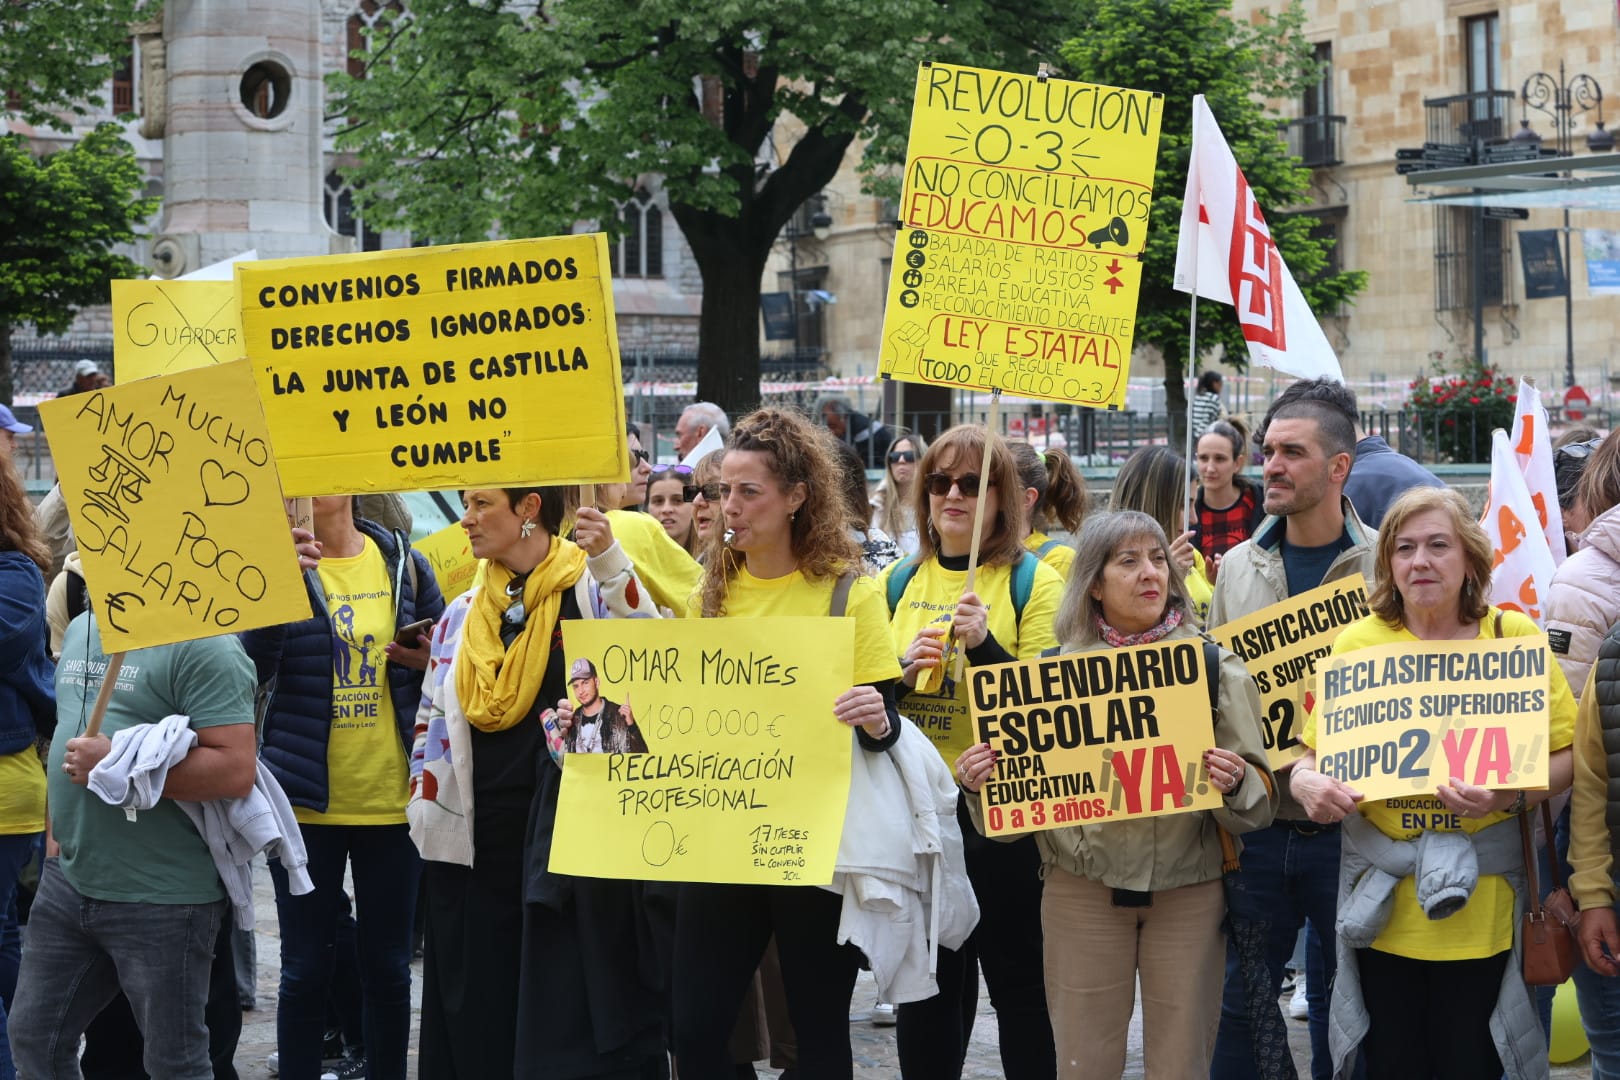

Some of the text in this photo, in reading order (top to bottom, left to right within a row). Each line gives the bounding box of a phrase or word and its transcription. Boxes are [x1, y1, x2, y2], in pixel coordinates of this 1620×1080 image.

[928, 68, 1152, 136] REVOLUCIÓN
[914, 161, 960, 197] NO
[908, 193, 1087, 248] EDUCAMOS
[928, 234, 1098, 272] BAJADA DE RATIOS
[258, 256, 578, 308] CONVENIOS FIRMADOS
[924, 272, 1090, 310] PAREJA EDUCATIVA
[928, 254, 1094, 291] SALARIOS JUSTOS
[272, 302, 592, 350] DERECHOS IGNORADOS:
[922, 292, 1132, 338] RECONOCIMIENTO DOCENTE
[943, 318, 1118, 369] LEY ESTATAL
[322, 366, 410, 393] JUNTA
[423, 360, 456, 386] DE
[469, 346, 588, 379] CASTILLA
[922, 358, 1103, 401] TODO EL CICLO 0-3
[974, 352, 1064, 376] QUE REGULE
[160, 384, 268, 467] MUCHO
[333, 394, 507, 432] Y LEÓN NO
[76, 392, 175, 473] AMOR
[77, 503, 240, 627] SALARIO
[175, 512, 267, 601] POCO
[64, 660, 85, 672] SAVE
[119, 666, 140, 678] RTH
[603, 644, 798, 686] OMAR MONTES
[973, 644, 1198, 711] CALENDARIO
[1324, 644, 1545, 700] RECLASIFICACIÓN
[332, 691, 370, 702] CACIÓN
[332, 704, 378, 718] EN PIE
[948, 705, 967, 714] 0-3
[1324, 689, 1544, 736] TÉCNICOS SUPERIORES
[928, 716, 952, 730] PIE
[977, 696, 1160, 756] ESCOLAR
[607, 748, 794, 782] RECLASIFICACIÓN
[618, 784, 768, 816] PROFESIONAL
[986, 772, 1096, 806] EDUCATIVA
[988, 797, 1113, 830] 0 a 3 años.
[1402, 812, 1462, 829] EN PIE
[749, 824, 809, 844] 17 MESES
[752, 843, 768, 854] SIN
[754, 858, 766, 866] EL
